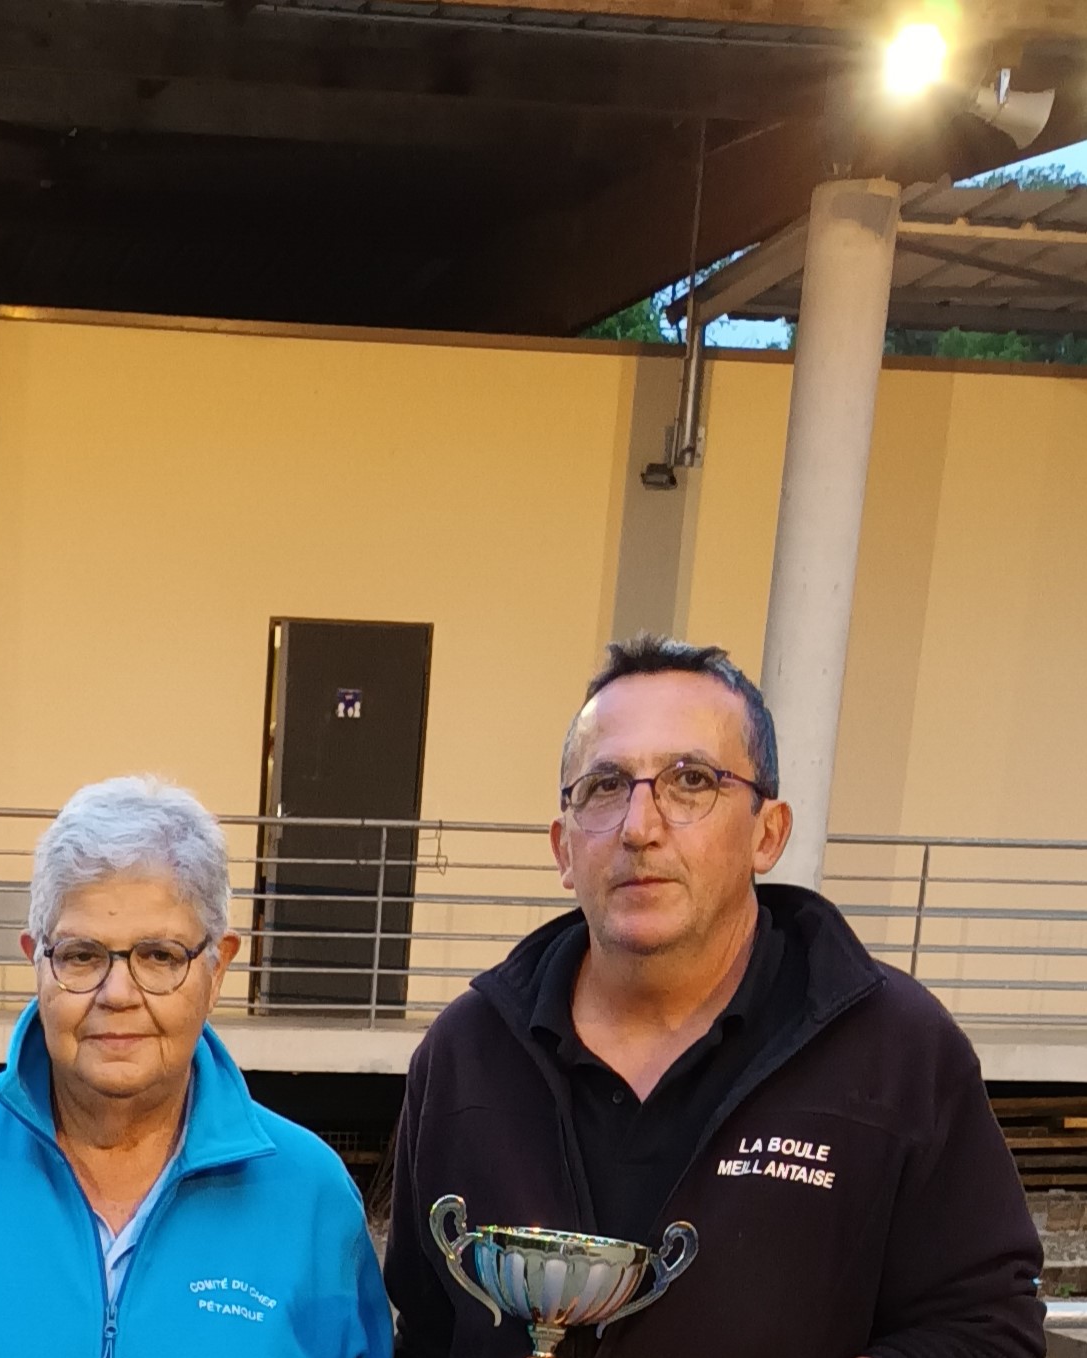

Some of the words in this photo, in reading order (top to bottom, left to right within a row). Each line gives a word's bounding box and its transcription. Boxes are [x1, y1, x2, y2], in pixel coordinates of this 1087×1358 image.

[738, 1137, 763, 1154] LA
[766, 1136, 831, 1162] BOULE
[717, 1159, 836, 1190] MEILLANTAISE
[189, 1277, 228, 1293] COMITÉ
[231, 1279, 249, 1292] DU
[249, 1286, 277, 1309] CHER
